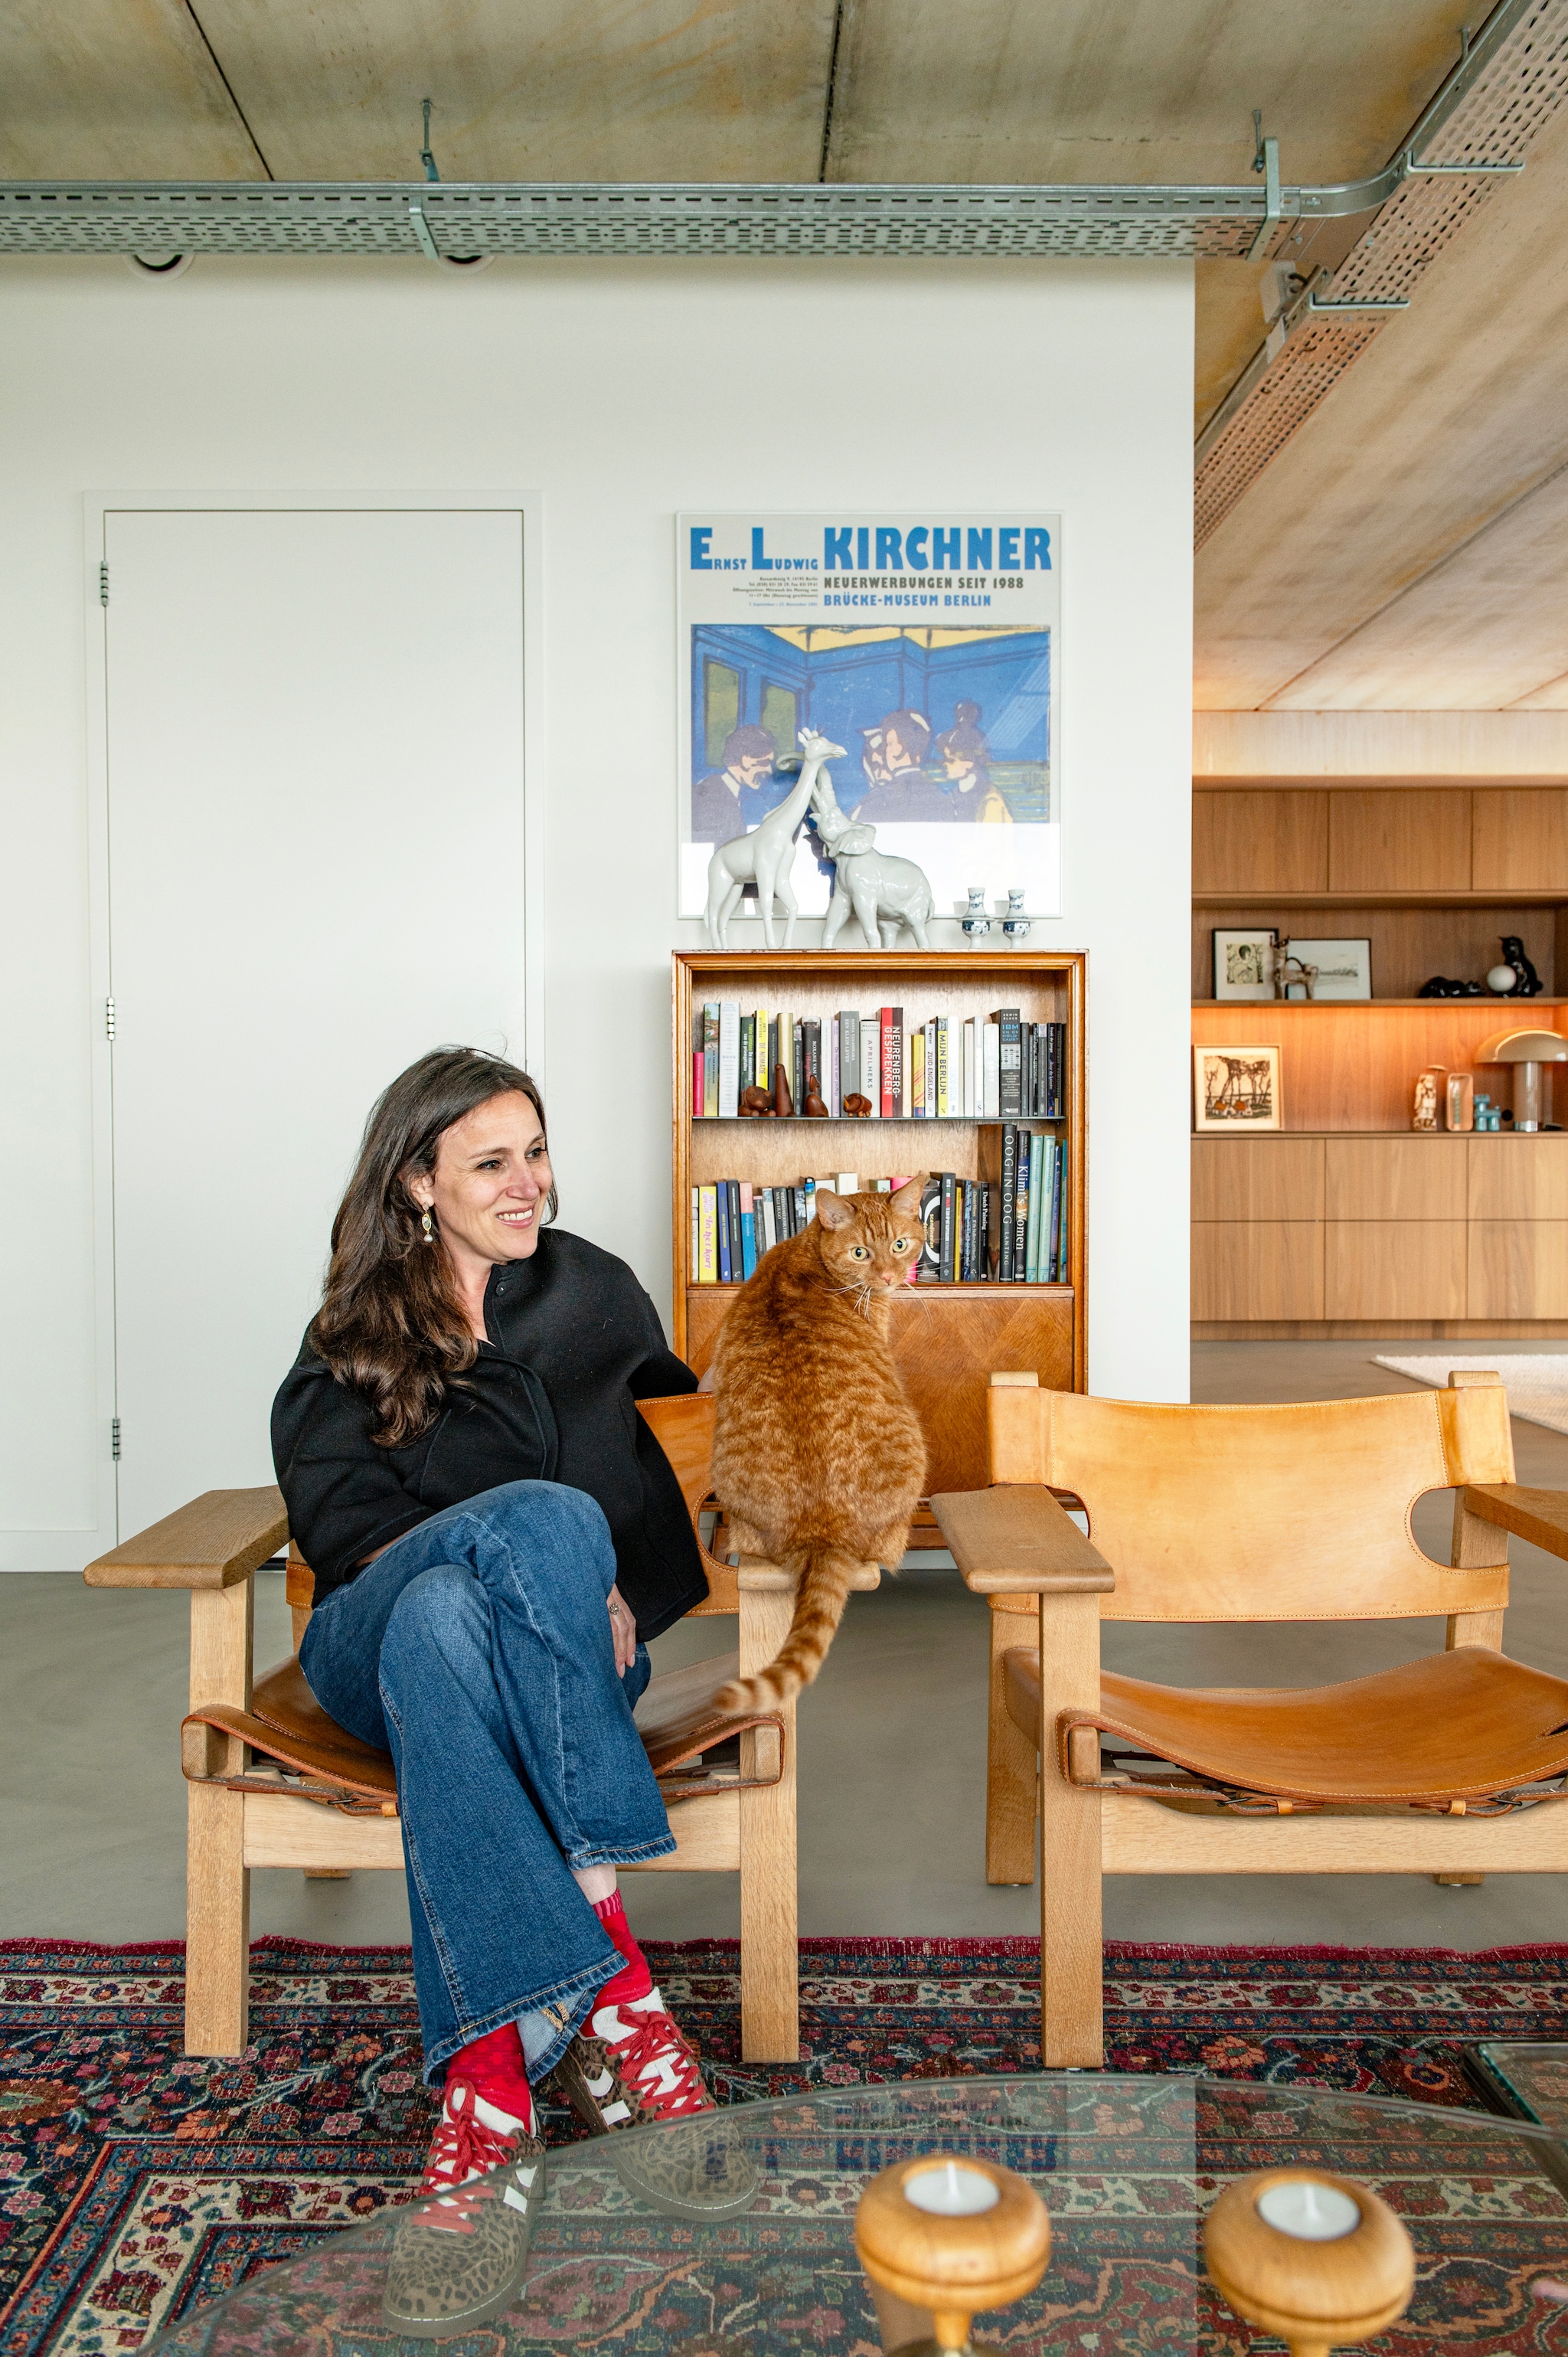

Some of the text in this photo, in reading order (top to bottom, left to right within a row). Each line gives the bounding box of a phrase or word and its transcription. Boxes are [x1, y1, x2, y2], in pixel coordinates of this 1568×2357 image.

[825, 526, 1052, 570] KIRCHNER
[825, 577, 1024, 588] NEUERWERBUNGEN SEIT 1988
[824, 592, 991, 606] BRÜCKE-MUSEUM BERLIN
[759, 1042, 766, 1051] DE
[1003, 1135, 1014, 1224] OOG IN OOG
[1016, 1165, 1028, 1250] Klimt's Women
[705, 1215, 714, 1228] In
[703, 1231, 713, 1246] het
[704, 1248, 713, 1269] kort
